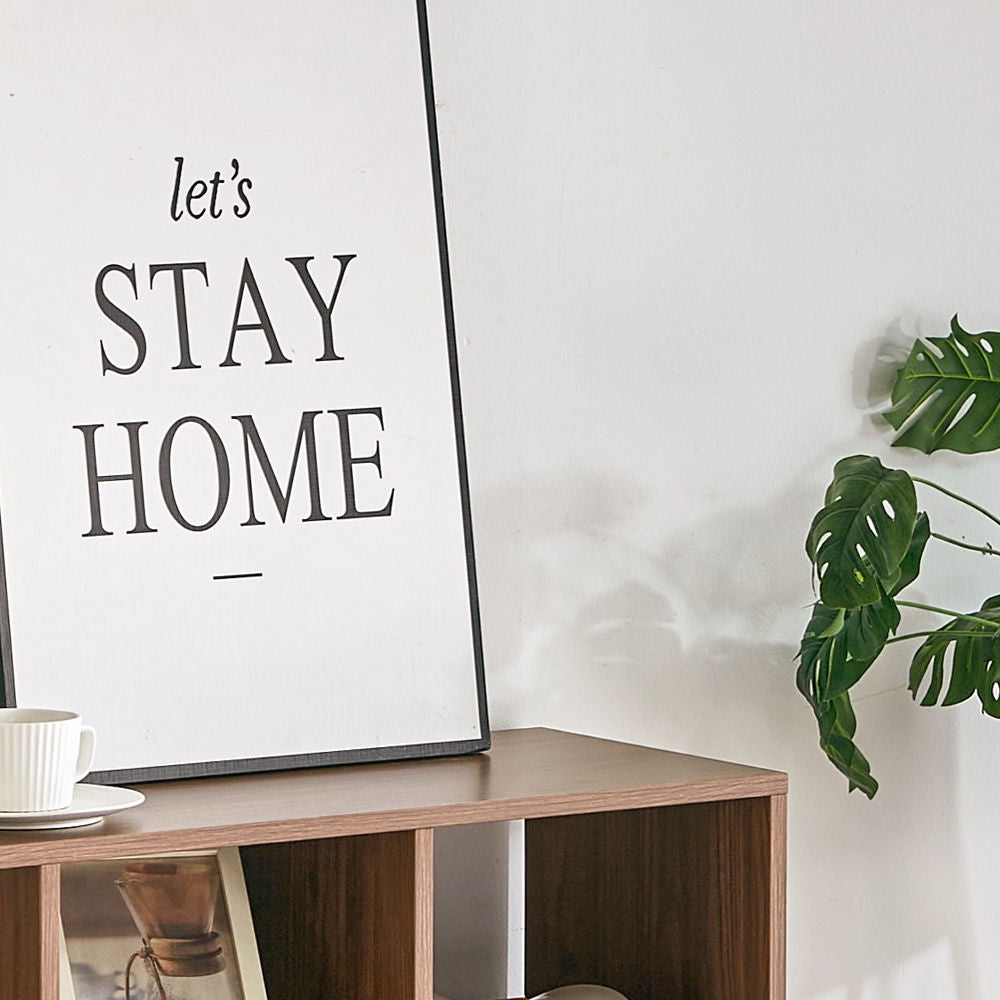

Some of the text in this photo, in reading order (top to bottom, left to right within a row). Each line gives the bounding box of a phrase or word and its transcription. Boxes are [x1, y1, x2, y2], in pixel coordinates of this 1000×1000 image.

[169, 156, 253, 222] let's
[94, 254, 358, 377] STAY
[72, 406, 396, 538] HOME
